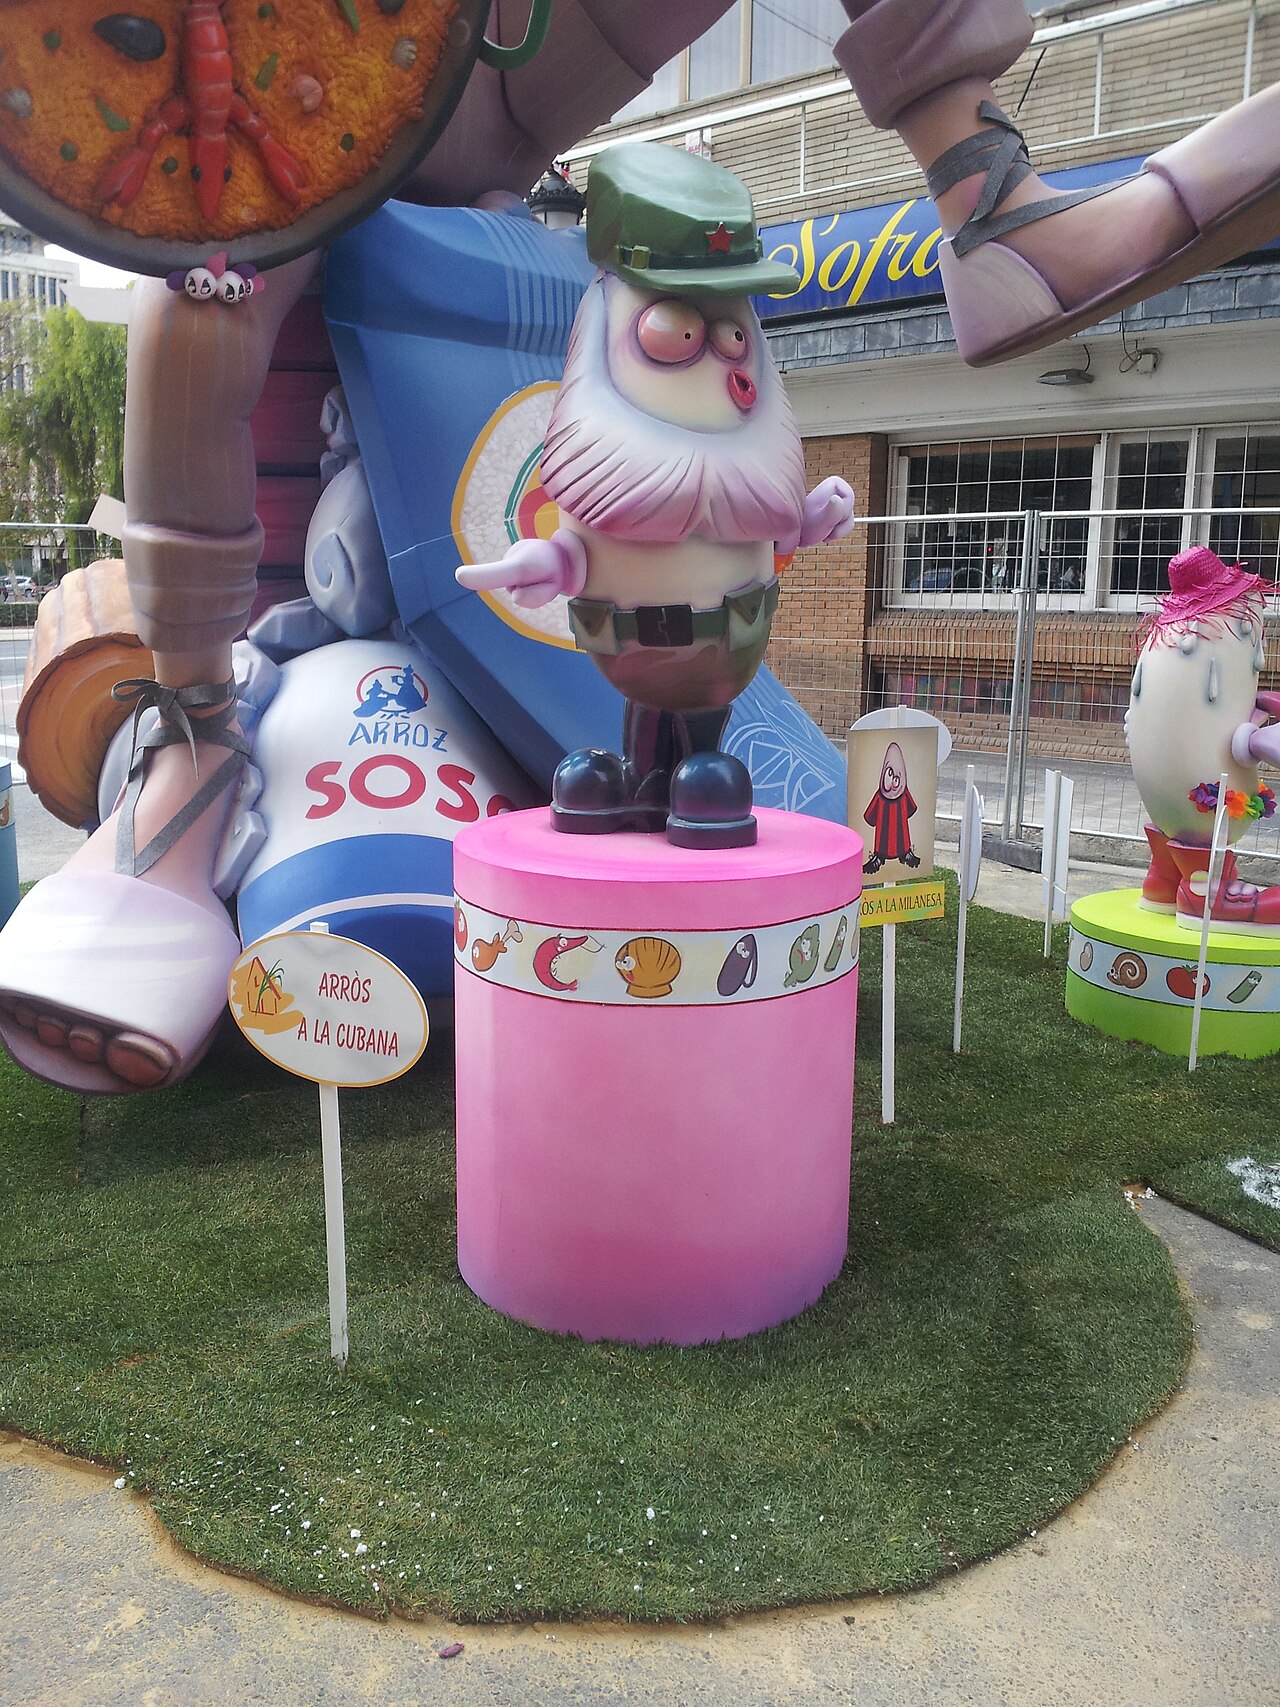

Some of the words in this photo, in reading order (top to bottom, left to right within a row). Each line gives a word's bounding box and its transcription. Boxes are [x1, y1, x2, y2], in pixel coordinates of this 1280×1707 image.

[348, 721, 448, 752] ARROZ
[859, 897, 875, 916] ÒS
[876, 899, 883, 914] A
[885, 898, 897, 913] LA
[899, 893, 942, 912] MILANESA
[318, 970, 372, 1004] ARRÒS
[297, 1016, 308, 1042] A
[313, 1018, 330, 1046] LA
[336, 1023, 399, 1058] CUBANA
